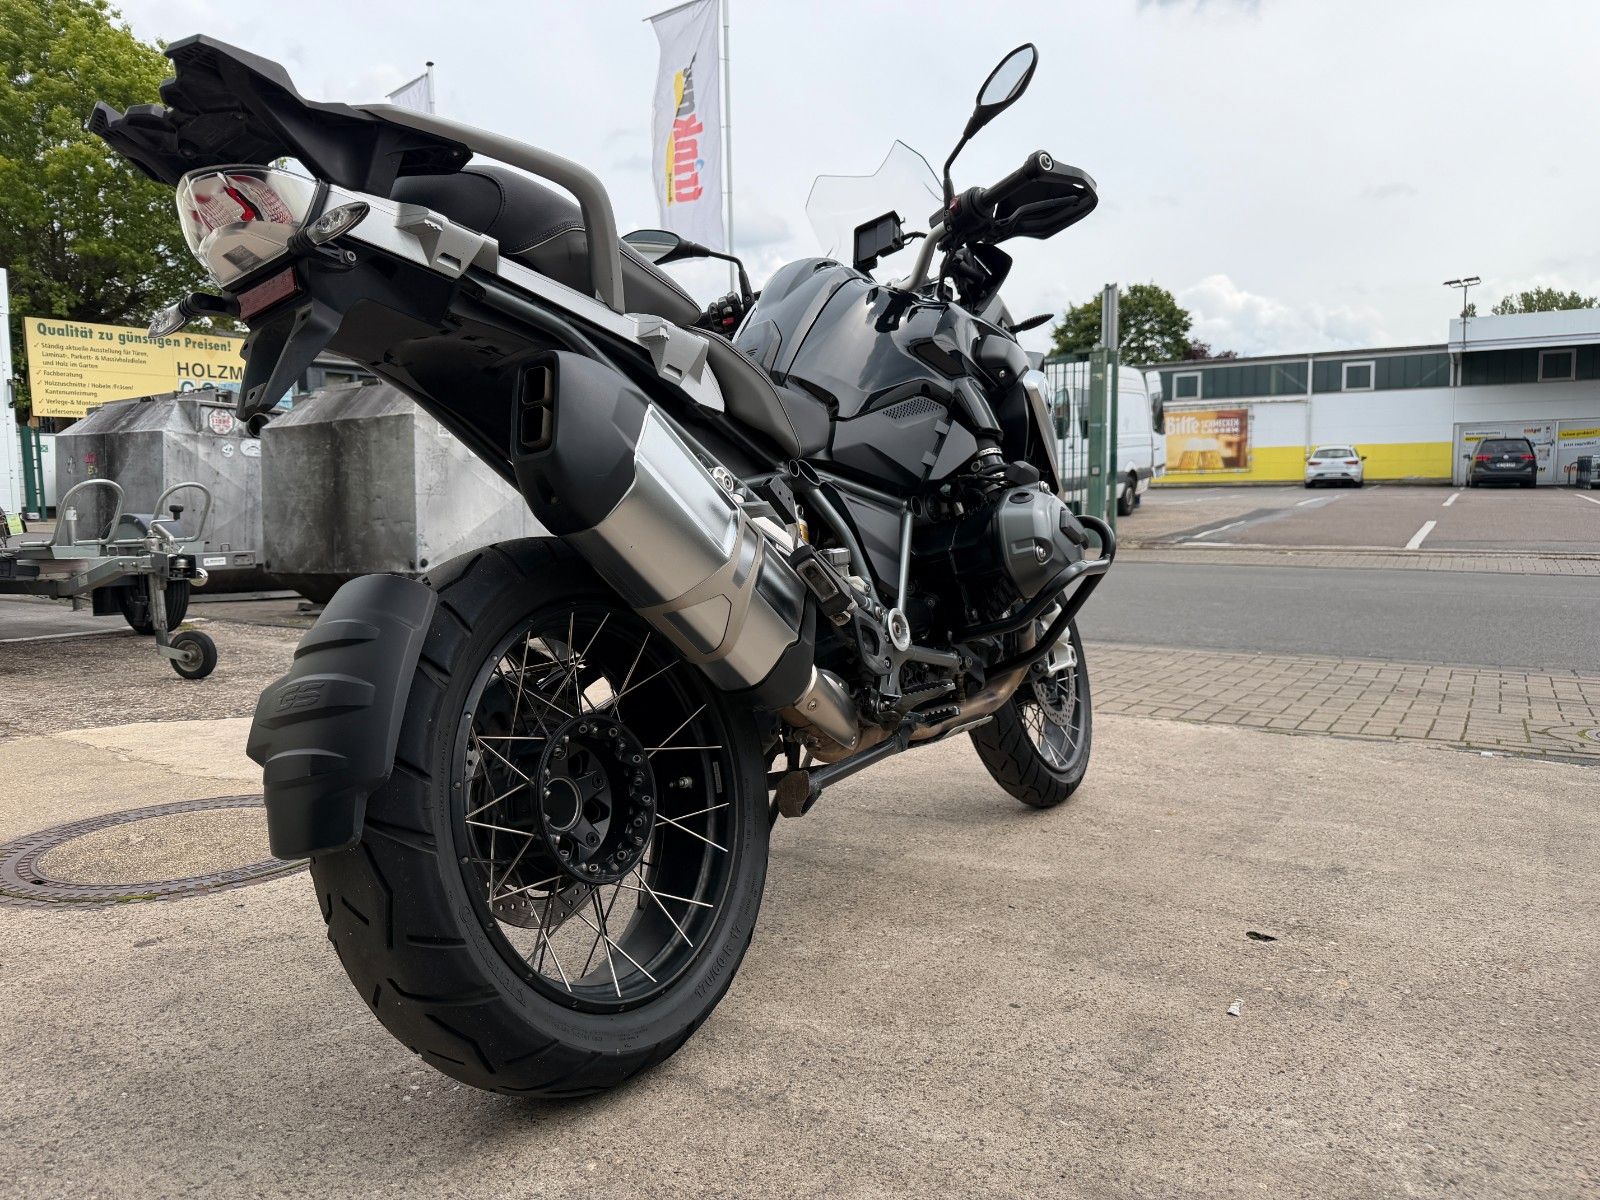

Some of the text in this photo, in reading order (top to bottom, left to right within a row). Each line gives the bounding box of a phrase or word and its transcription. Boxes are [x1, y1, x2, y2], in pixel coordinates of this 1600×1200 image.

[37, 322, 93, 339] Qualität
[98, 331, 113, 341] zu
[185, 337, 231, 352] Preisen!
[41, 342, 64, 351] Ständig
[65, 344, 88, 352] aktuelle
[89, 346, 121, 355] Ausstellung
[122, 348, 131, 356] für
[43, 370, 83, 379] Fachberatung
[44, 380, 86, 388] Holzzuschnitte
[46, 408, 83, 416] Lieferservice
[275, 681, 327, 712] GS
